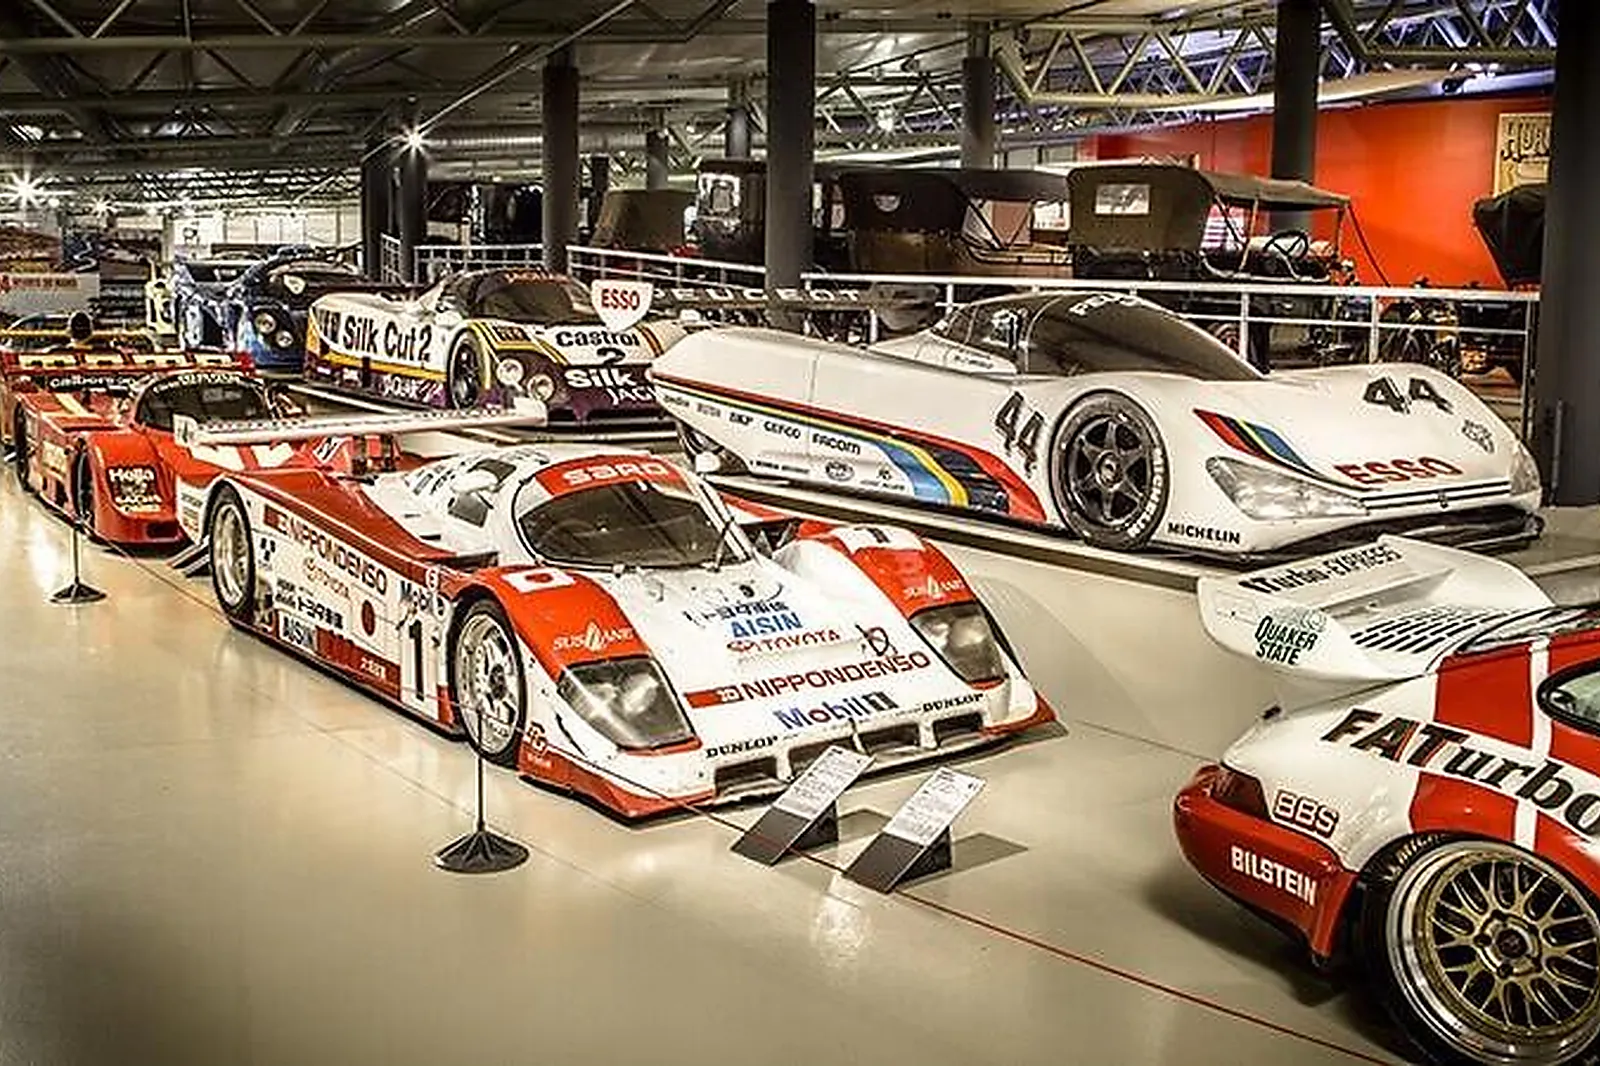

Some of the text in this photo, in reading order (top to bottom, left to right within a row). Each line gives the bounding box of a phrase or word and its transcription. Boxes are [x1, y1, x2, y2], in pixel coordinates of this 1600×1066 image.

[601, 288, 641, 311] ESSO
[342, 315, 433, 363] Silk Cut 2
[563, 368, 638, 388] Silk
[1362, 376, 1454, 416] 44
[995, 390, 1046, 479] 44
[1333, 456, 1464, 485] ESSO
[1167, 522, 1242, 546] MICHELIN
[289, 517, 388, 596] NIPPONDENSO
[730, 611, 803, 639] AISIN
[761, 629, 841, 651] TOYOTA
[1255, 615, 1319, 651] QUAKER
[409, 619, 425, 702] 1
[1256, 640, 1301, 666] STATE
[741, 651, 931, 700] NIPPONDENSO
[772, 698, 864, 731] Mobil
[922, 692, 986, 713] DUNLOP
[705, 734, 779, 759] DUNLOP
[1275, 789, 1340, 839] BBS
[1230, 846, 1318, 907] BILSTEIN
